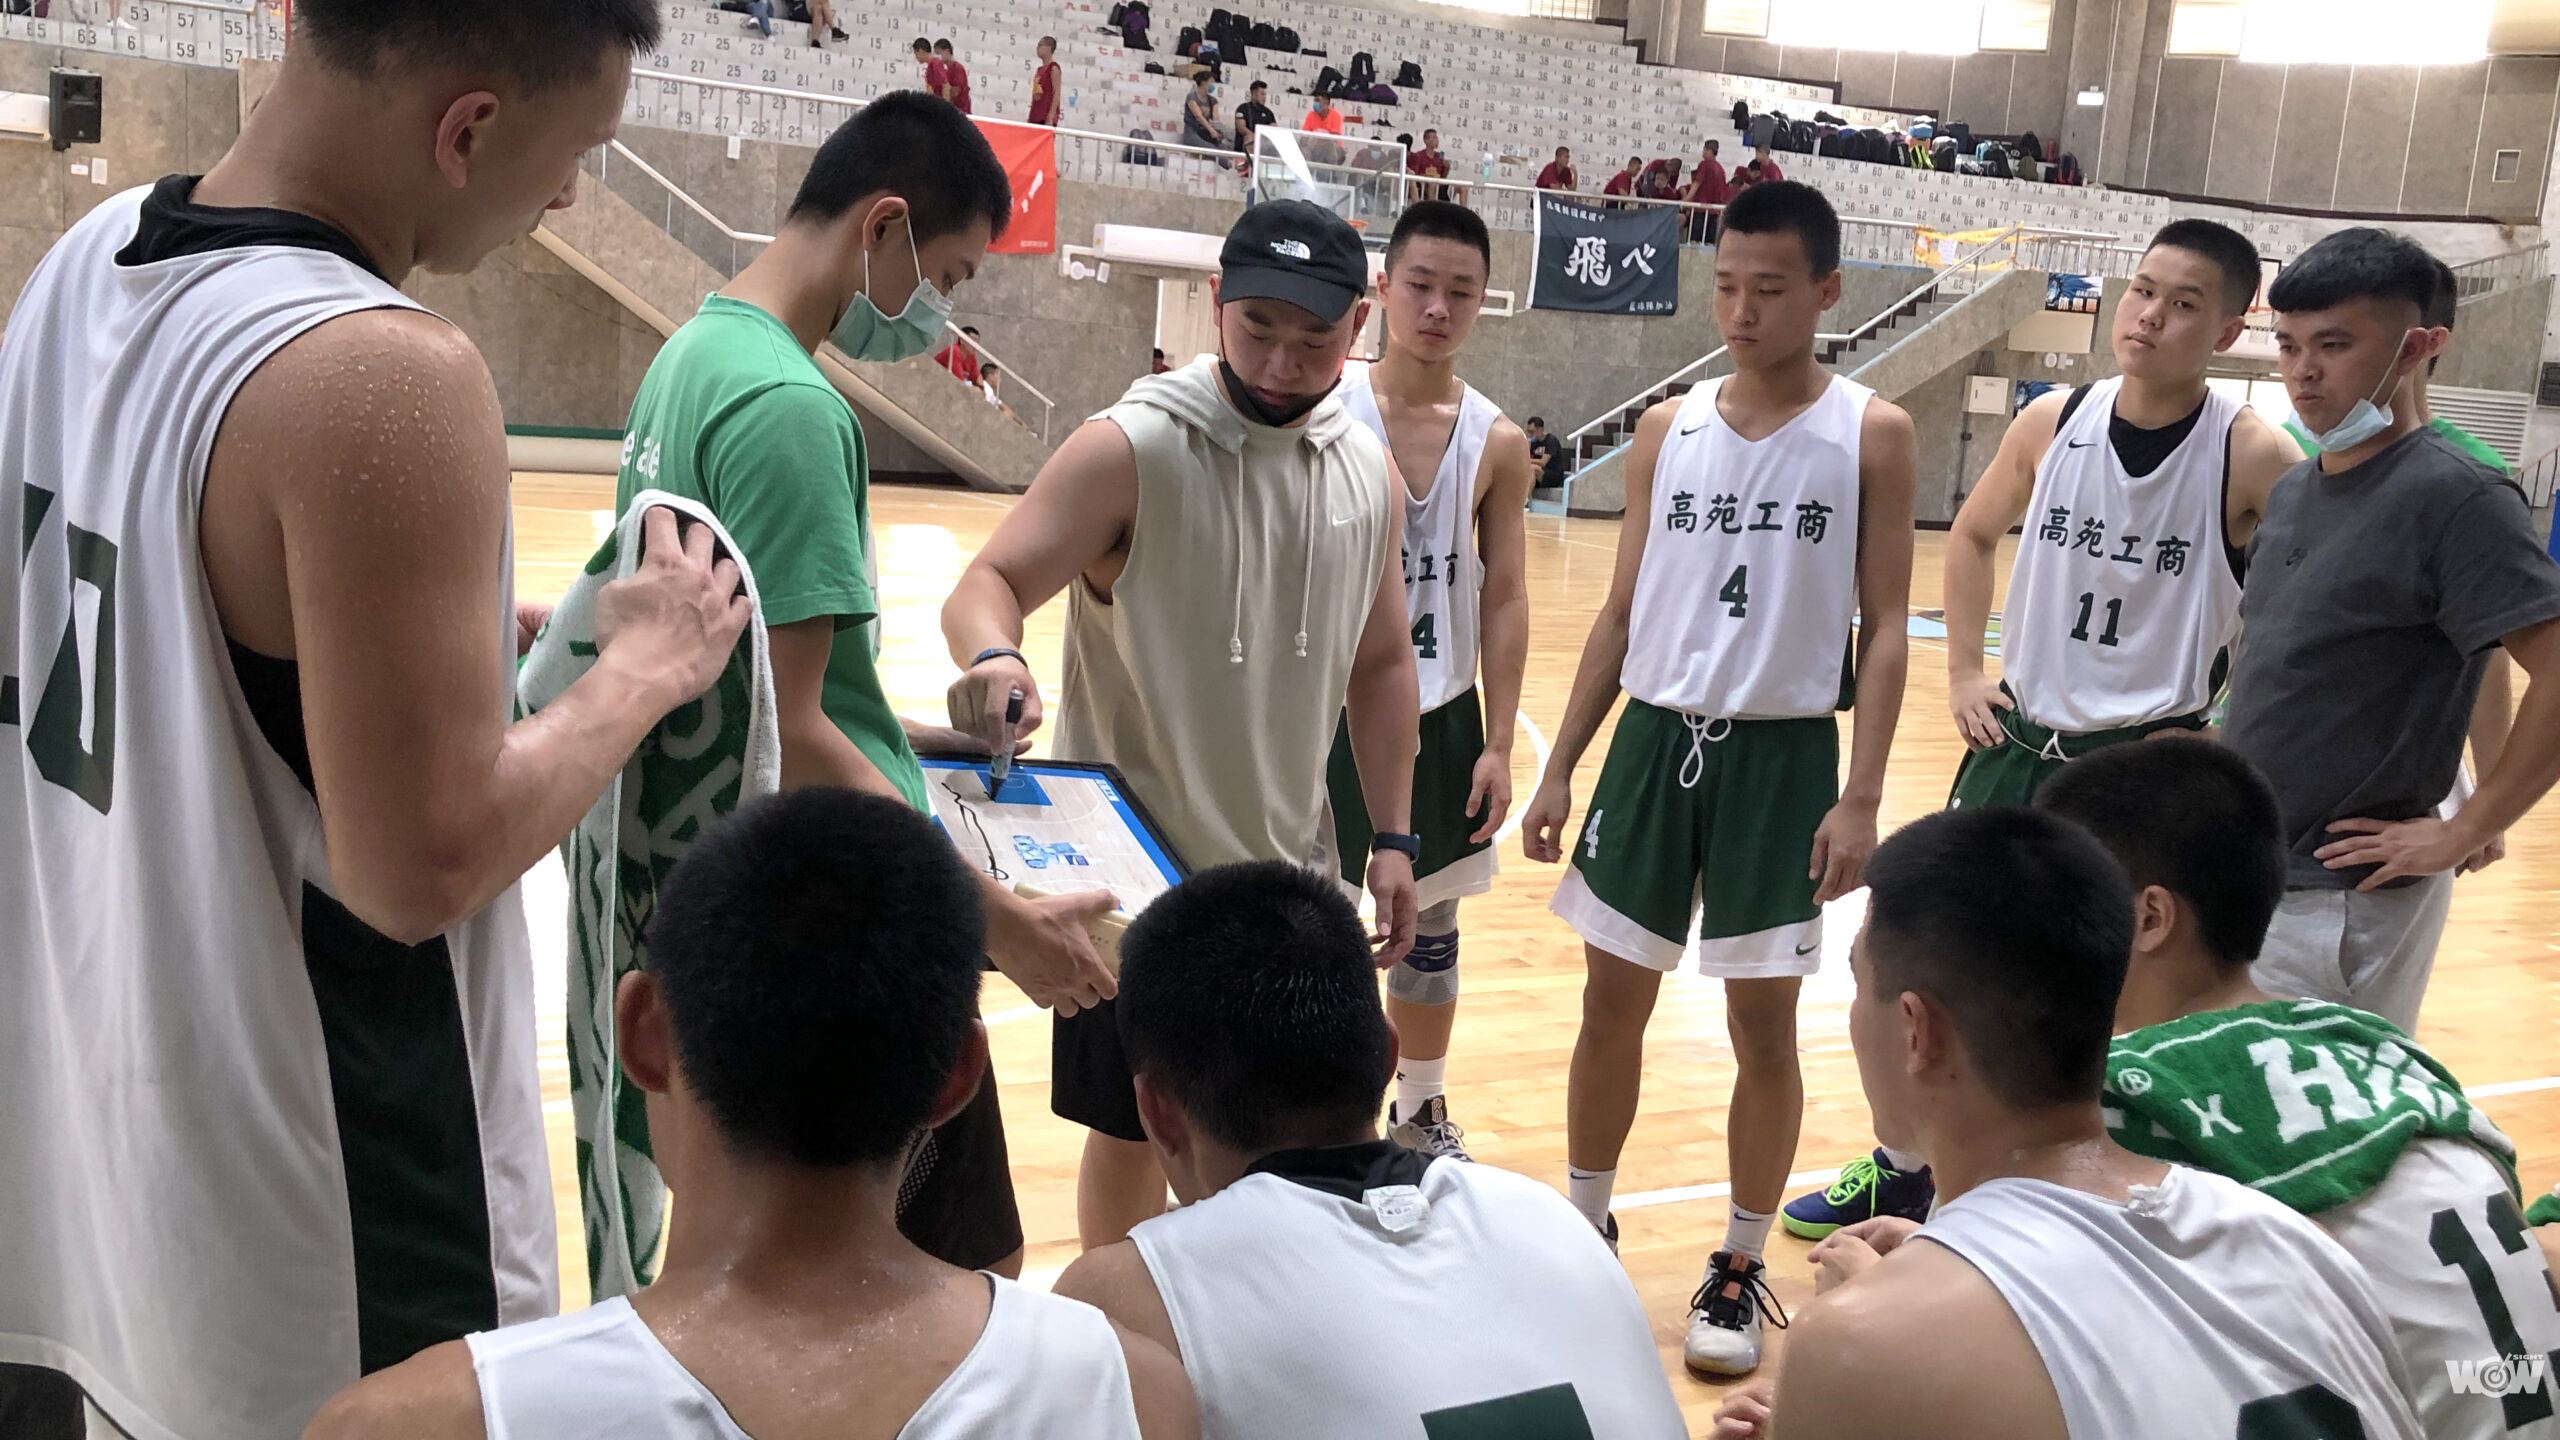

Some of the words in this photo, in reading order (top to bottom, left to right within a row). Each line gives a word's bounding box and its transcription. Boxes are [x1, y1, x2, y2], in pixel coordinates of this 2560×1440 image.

[178, 14, 195, 28] 57
[224, 20, 243, 36] 55
[672, 6, 685, 19] 27
[706, 12, 719, 24] 25
[856, 14, 868, 25] 15
[888, 19, 899, 29] 13
[1353, 12, 1363, 22] 24
[1424, 22, 1434, 32] 30
[1448, 25, 1458, 34] 32
[1472, 29, 1481, 38] 34
[1541, 37, 1550, 47] 40
[1565, 41, 1574, 50] 42
[1587, 44, 1596, 54] 44
[77, 29, 96, 45] 63
[176, 42, 195, 58] 59
[681, 33, 695, 45] 27
[716, 38, 730, 50] 25
[750, 43, 764, 55] 23
[784, 48, 796, 60] 21
[820, 54, 830, 65] 19
[852, 58, 864, 69] 17
[884, 62, 896, 74] 15
[871, 38, 881, 49] 15
[1371, 33, 1381, 42] 24
[1469, 46, 1478, 56] 32
[1492, 50, 1502, 59] 34
[1563, 59, 1572, 69] 40
[1586, 62, 1595, 71] 42
[1609, 65, 1618, 74] 44
[655, 54, 669, 68] 29
[691, 60, 705, 73] 27
[726, 65, 741, 77] 25
[762, 69, 776, 82] 23
[797, 74, 808, 86] 21
[832, 79, 844, 91] 19
[865, 84, 877, 96] 17
[1466, 62, 1476, 72] 30
[1515, 69, 1524, 78] 34
[1586, 78, 1595, 88] 40
[1609, 81, 1618, 91] 42
[1632, 84, 1642, 94] 44
[1655, 87, 1665, 97] 46
[663, 81, 678, 94] 29
[700, 87, 714, 100] 27
[736, 92, 751, 105] 25
[773, 96, 786, 110] 23
[638, 106, 651, 119] 31
[715, 116, 728, 129] 27
[1434, 96, 1444, 105] 24
[1558, 112, 1568, 121] 34
[1656, 124, 1665, 134] 42
[1680, 126, 1689, 136] 44
[1457, 118, 1468, 128] 24
[1582, 133, 1593, 143] 34
[1579, 175, 1590, 186] 30
[1779, 154, 1788, 164] 52
[1802, 156, 1812, 167] 54
[1873, 167, 1882, 176] 60
[1896, 169, 1905, 179] 62
[1918, 172, 1928, 182] 64
[1941, 175, 1950, 185] 66
[1988, 180, 1996, 190] 70
[2010, 183, 2019, 192] 72
[2034, 185, 2042, 195] 74
[1835, 183, 1845, 192] 56
[1906, 190, 1916, 200] 62
[2000, 201, 2009, 211] 70
[2023, 204, 2032, 214] 72
[2046, 207, 2055, 216] 74
[2069, 209, 2079, 219] 76
[2268, 225, 2279, 234] 92
[1845, 202, 1855, 212] 56
[1893, 208, 1903, 217] 60
[1917, 211, 1927, 220] 62
[1667, 490, 1834, 544] 高苑工商
[2039, 505, 2192, 577] 高苑工商
[1719, 564, 1749, 618] 4
[2070, 592, 2123, 647] 11
[1584, 809, 1603, 859] 4
